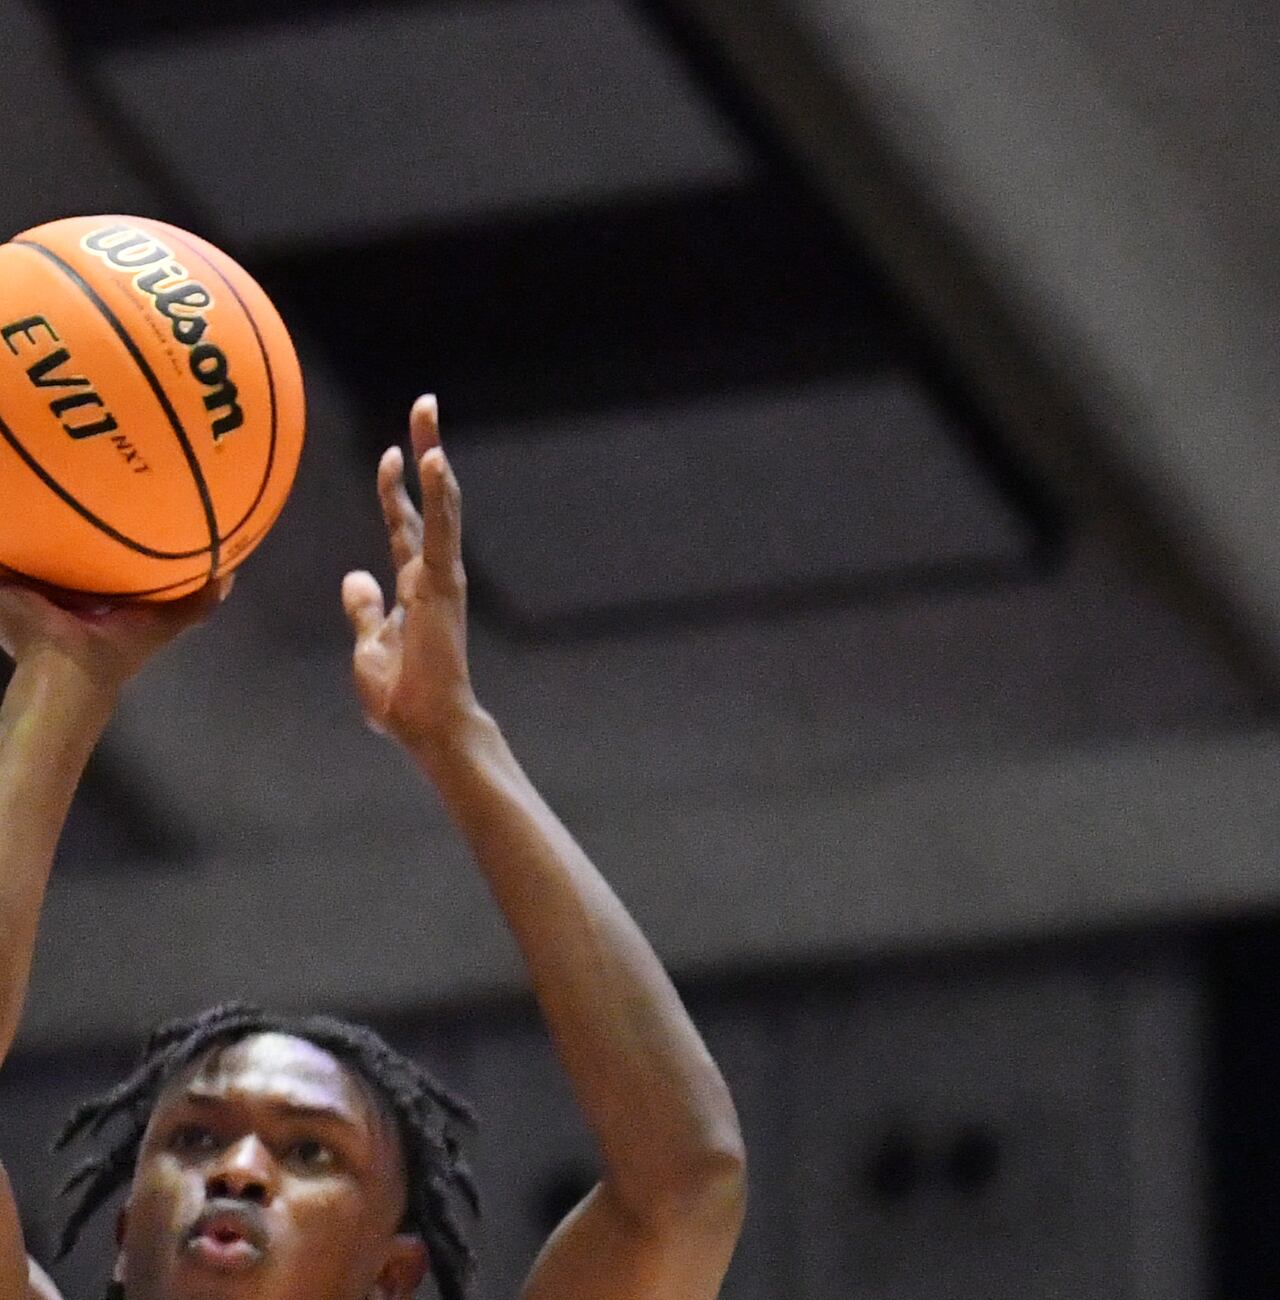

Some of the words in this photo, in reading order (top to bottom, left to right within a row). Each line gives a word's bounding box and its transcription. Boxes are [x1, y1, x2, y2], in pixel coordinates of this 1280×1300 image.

[0, 315, 119, 440] EVO
[112, 435, 151, 474] NXT
[80, 221, 245, 447] Wilson
